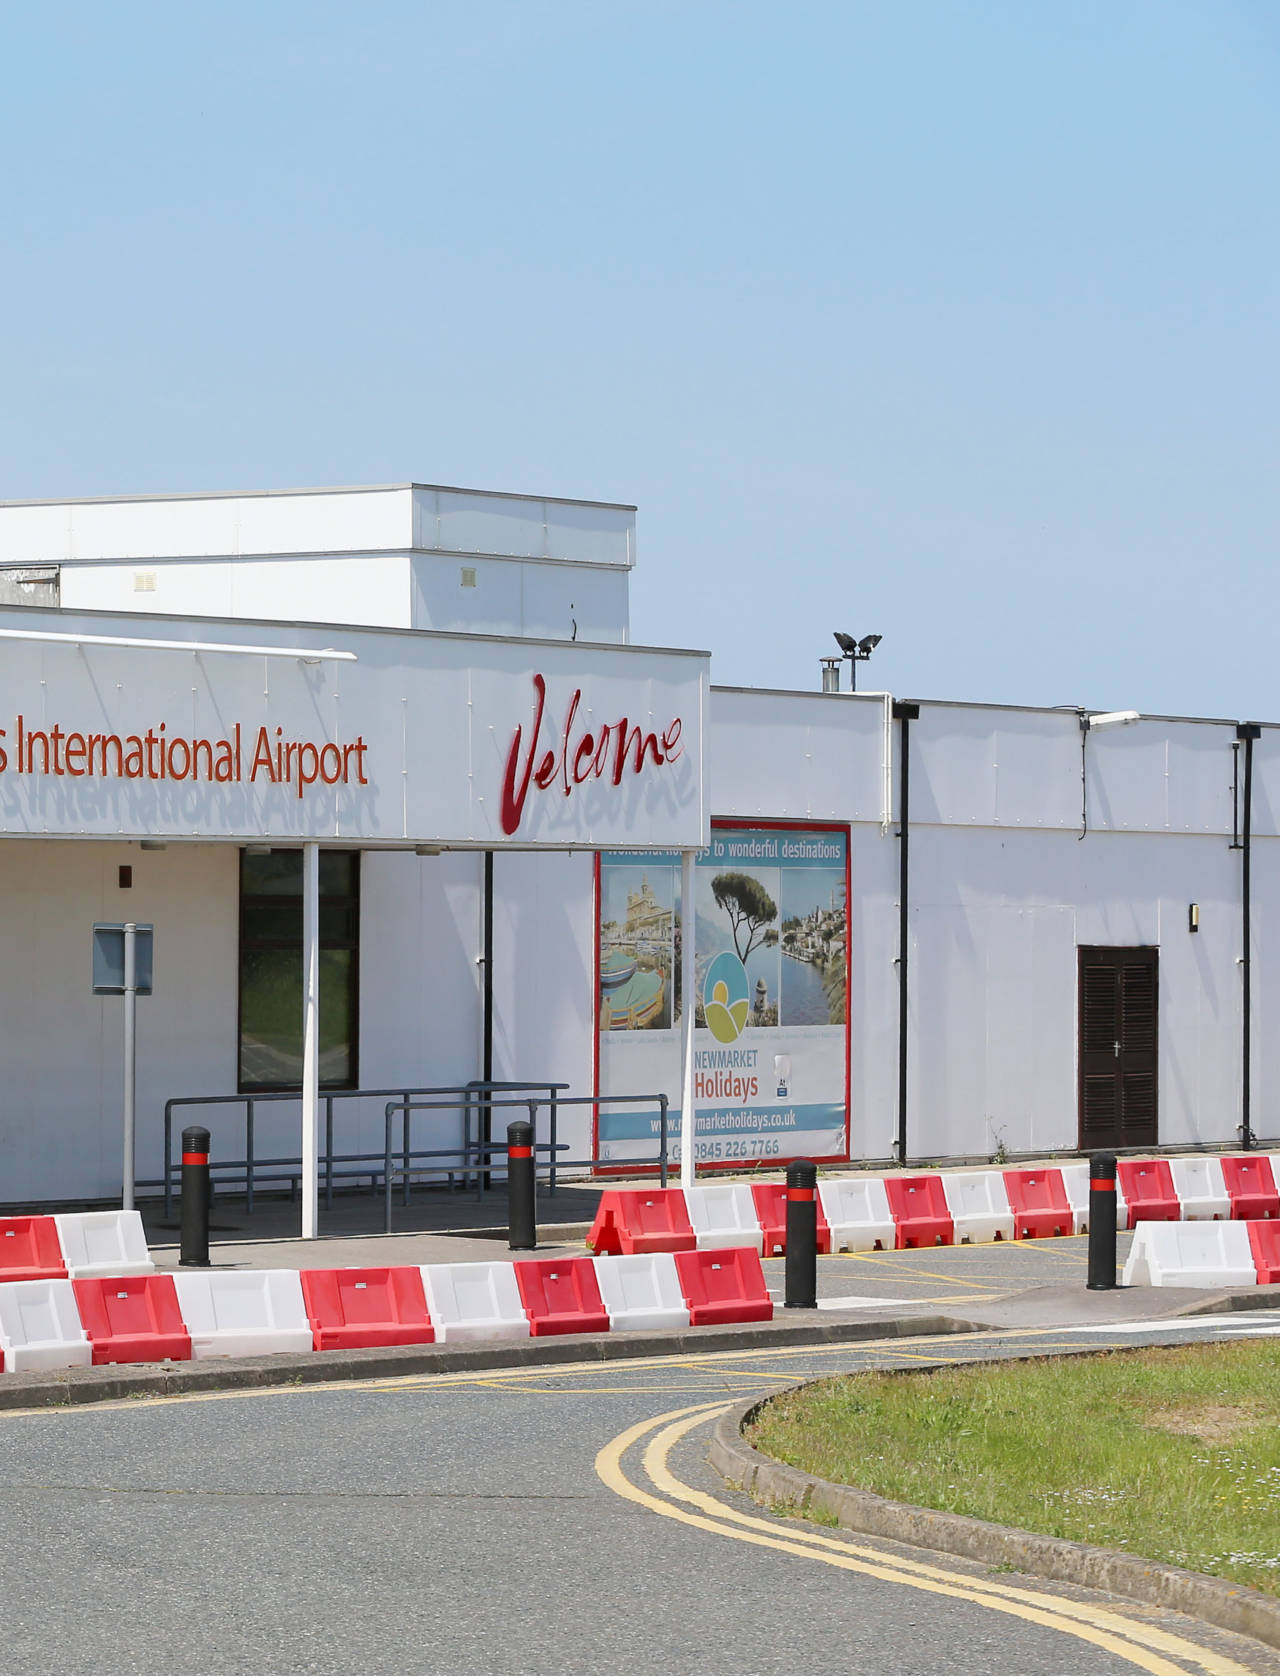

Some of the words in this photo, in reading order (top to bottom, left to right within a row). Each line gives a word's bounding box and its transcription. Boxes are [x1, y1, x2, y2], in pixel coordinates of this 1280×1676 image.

[18, 715, 240, 782] International
[251, 727, 367, 798] Airport
[714, 843, 725, 857] to
[729, 840, 778, 858] wonderful
[782, 840, 841, 859] destinations
[695, 1049, 758, 1069] NEWMARKET
[695, 1070, 758, 1103] Holidays
[725, 1140, 747, 1157] 226
[751, 1139, 779, 1155] 7766
